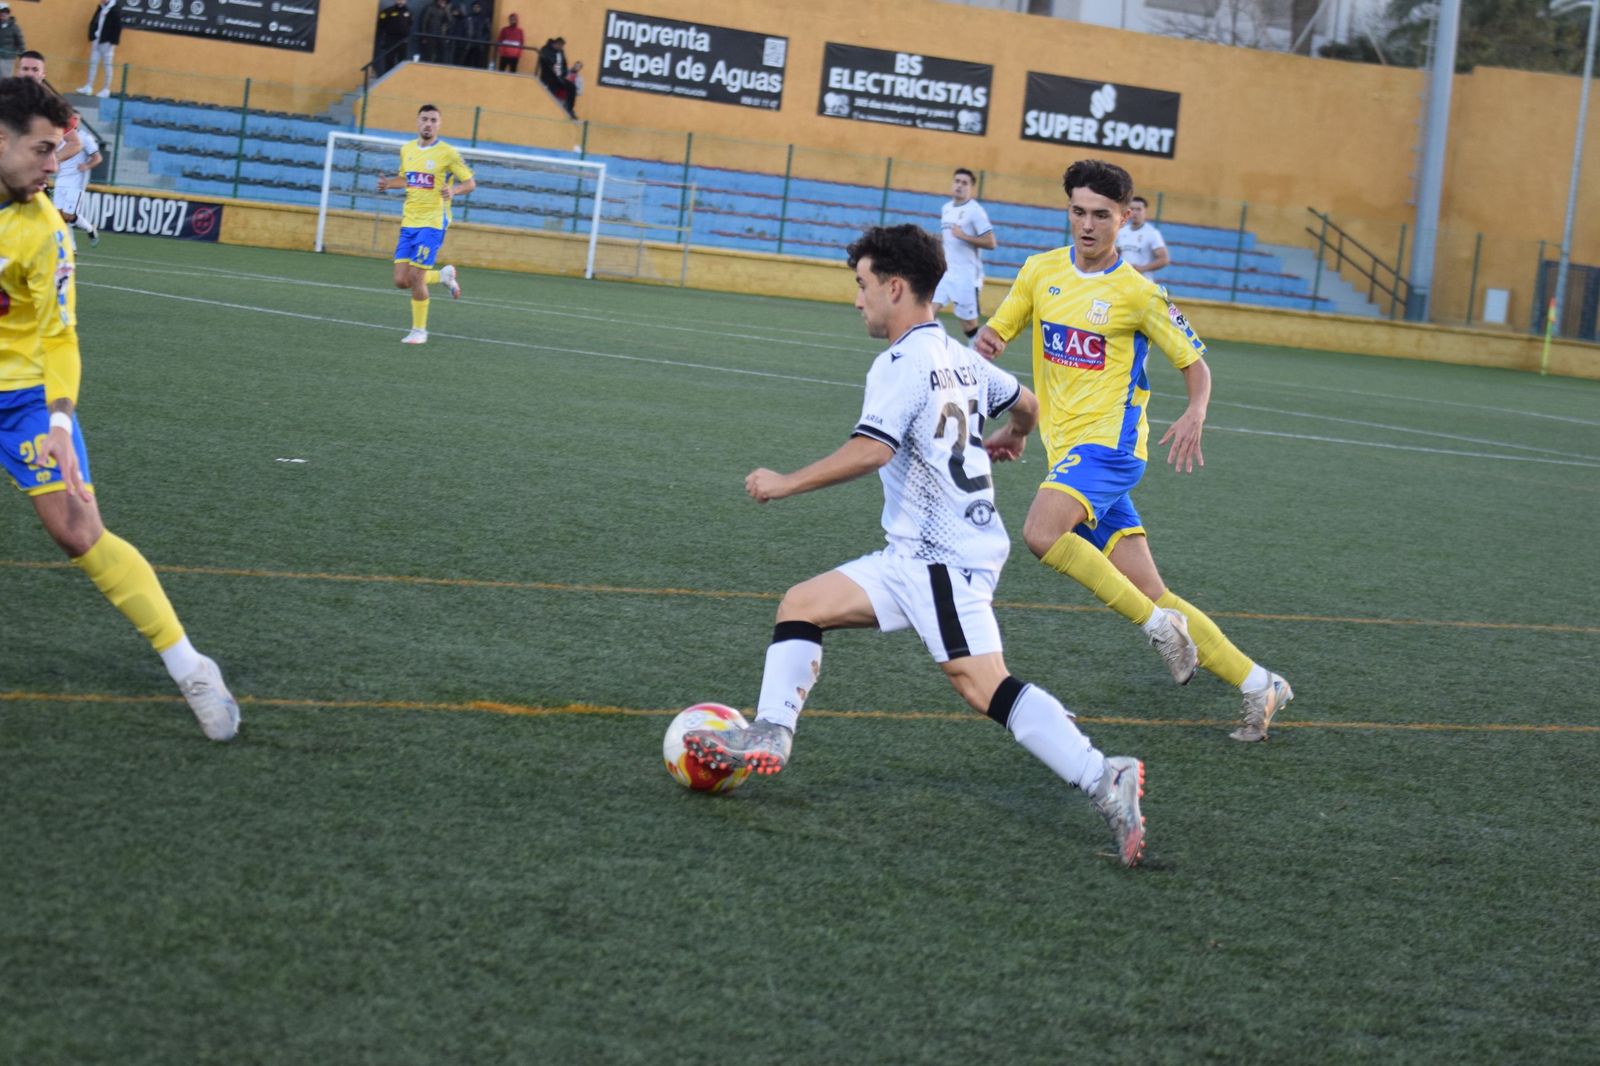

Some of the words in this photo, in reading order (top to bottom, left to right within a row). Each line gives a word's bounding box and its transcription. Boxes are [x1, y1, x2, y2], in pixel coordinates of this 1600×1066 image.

[607, 13, 710, 52] Imprenta
[603, 44, 672, 78] Papel
[675, 55, 706, 82] de
[709, 60, 782, 93] Aguas
[895, 53, 923, 76] BS
[828, 67, 988, 108] ELECTRICISTAS
[1025, 110, 1099, 144] SUPER
[1102, 120, 1175, 153] SPORT
[79, 192, 188, 237] MPULSO27
